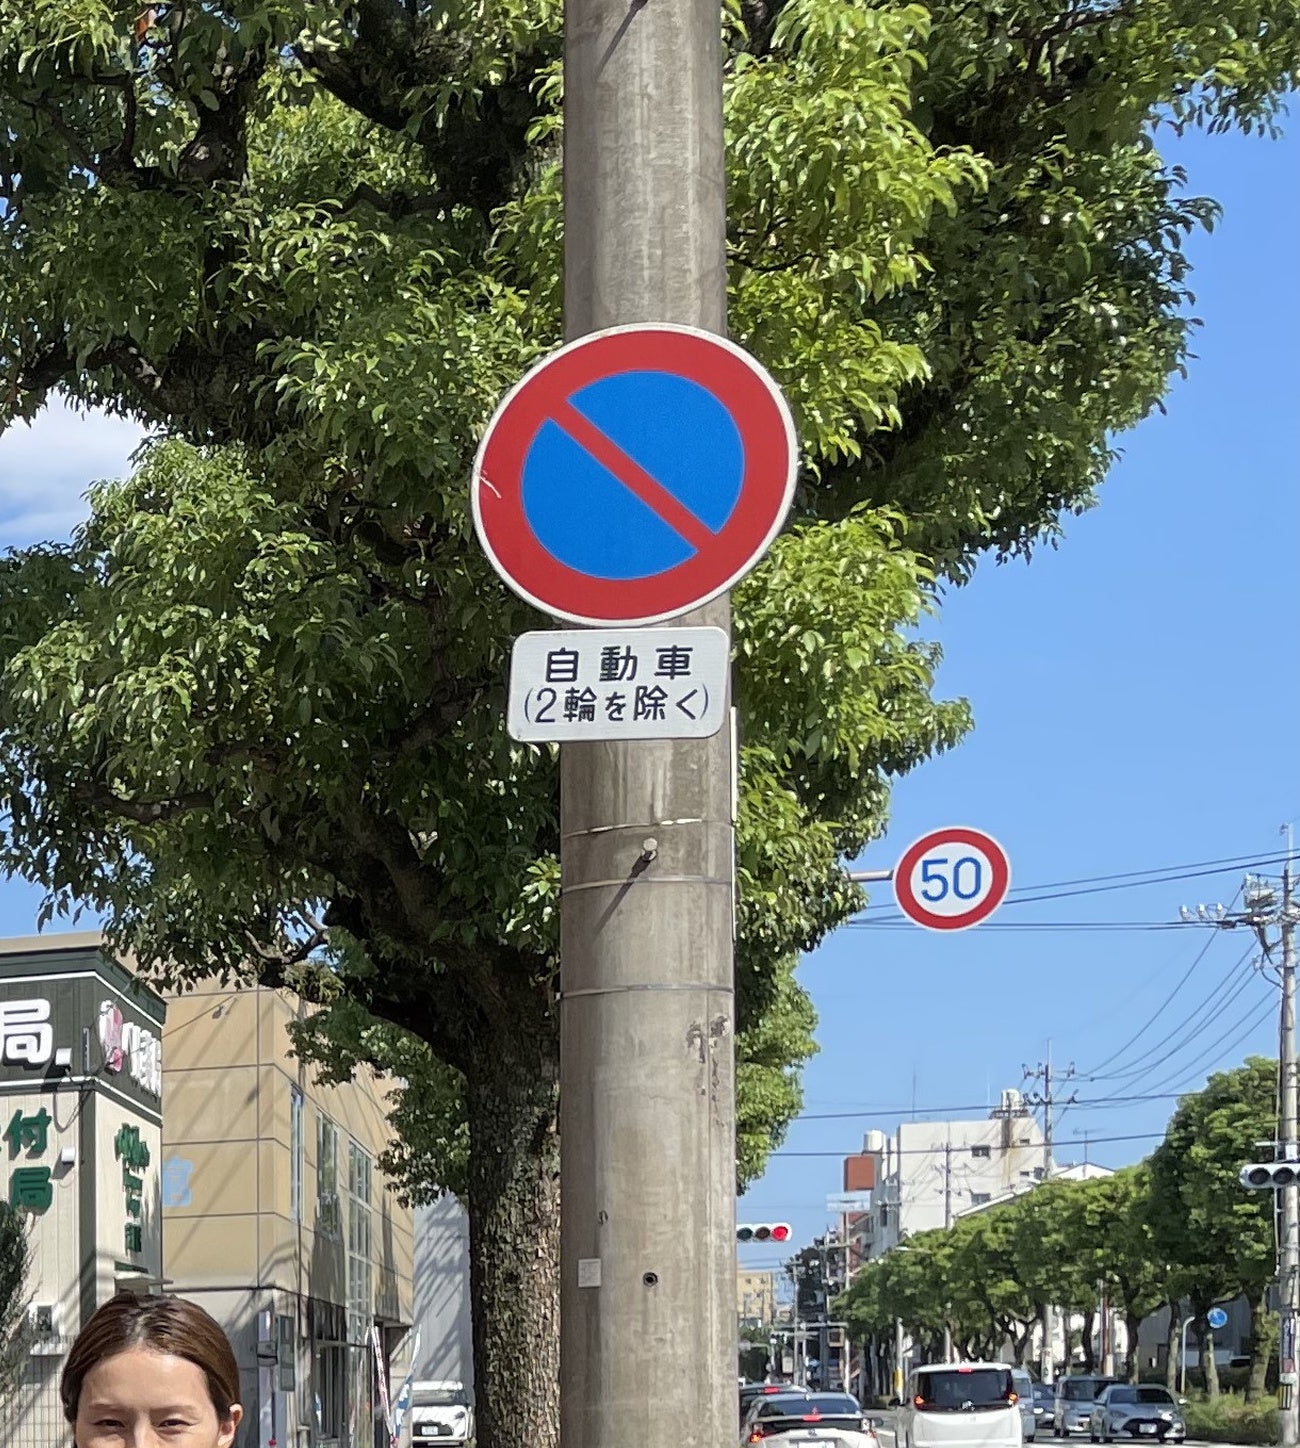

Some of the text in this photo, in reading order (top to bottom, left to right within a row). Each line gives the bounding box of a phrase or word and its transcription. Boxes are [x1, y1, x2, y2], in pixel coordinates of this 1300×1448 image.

[545, 644, 693, 683] 自動車
[920, 856, 983, 903] 50
